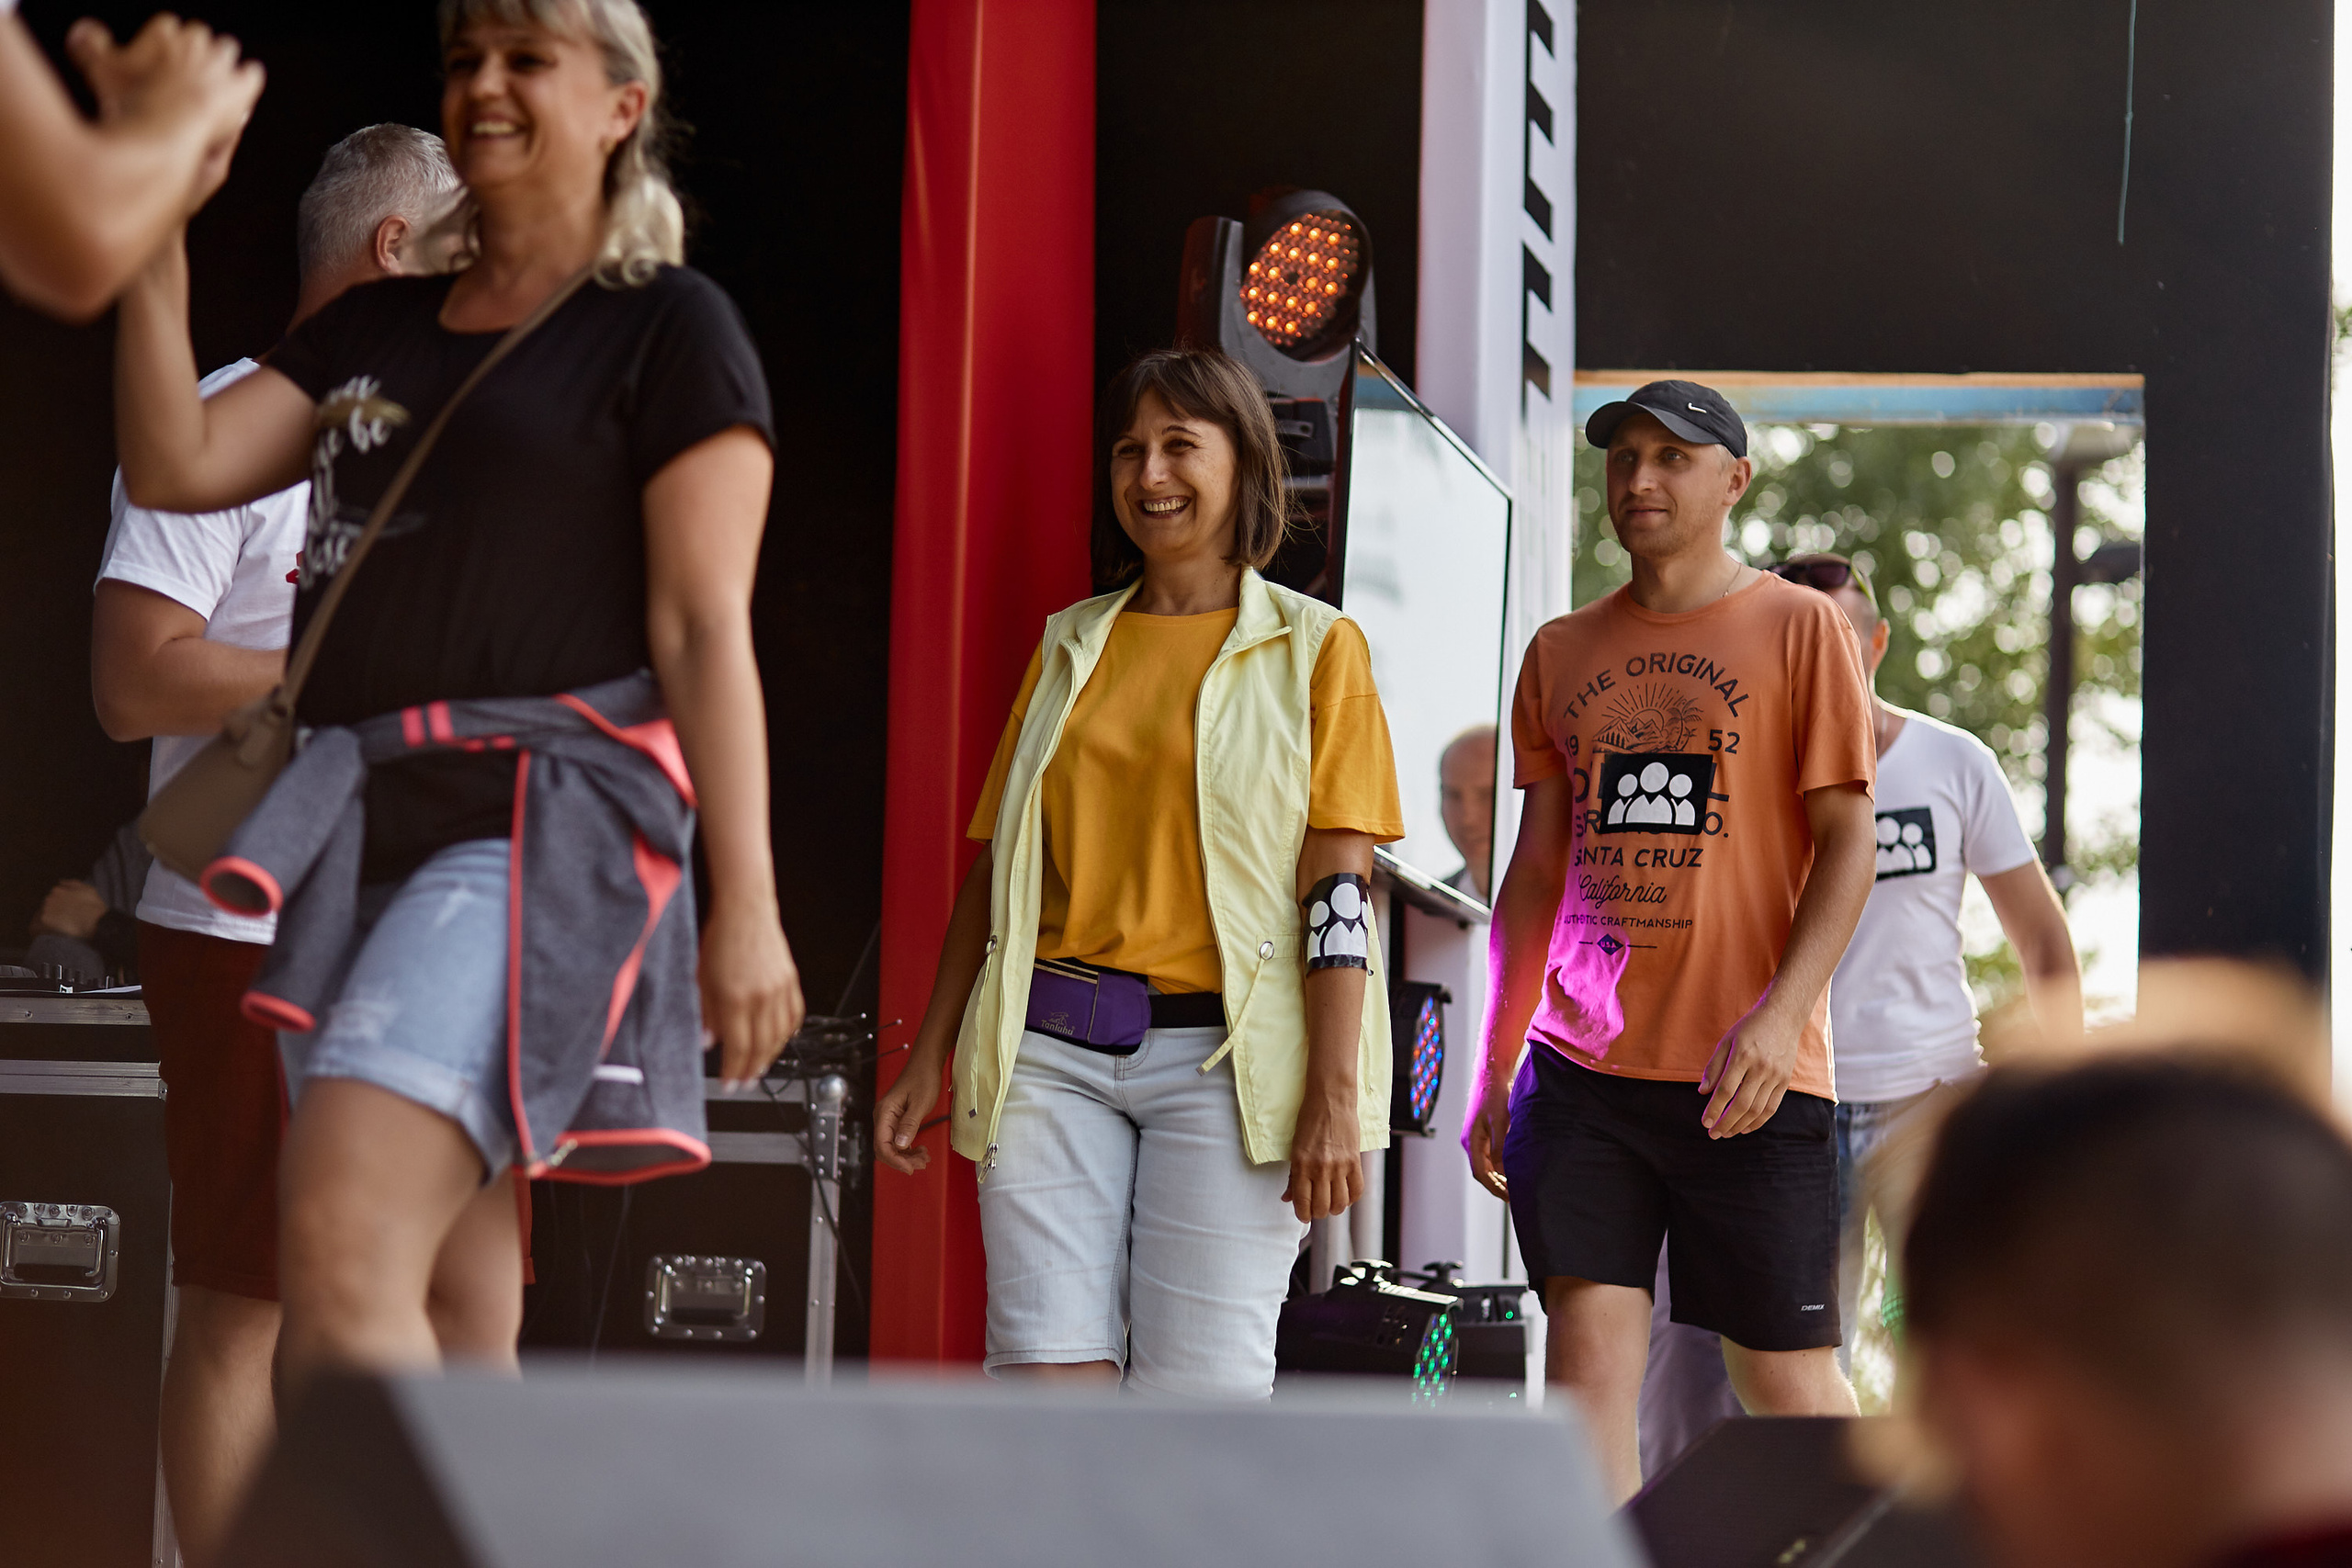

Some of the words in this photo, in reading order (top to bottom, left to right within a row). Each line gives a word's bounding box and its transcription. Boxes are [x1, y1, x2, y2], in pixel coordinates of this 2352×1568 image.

[1563, 669, 1616, 719] THE
[1625, 652, 1749, 717] ORIGINAL
[1707, 729, 1741, 754] 52
[1634, 848, 1704, 868] CRUZ
[1578, 874, 1668, 909] California
[1600, 916, 1693, 930] CRAFTMANSHIP
